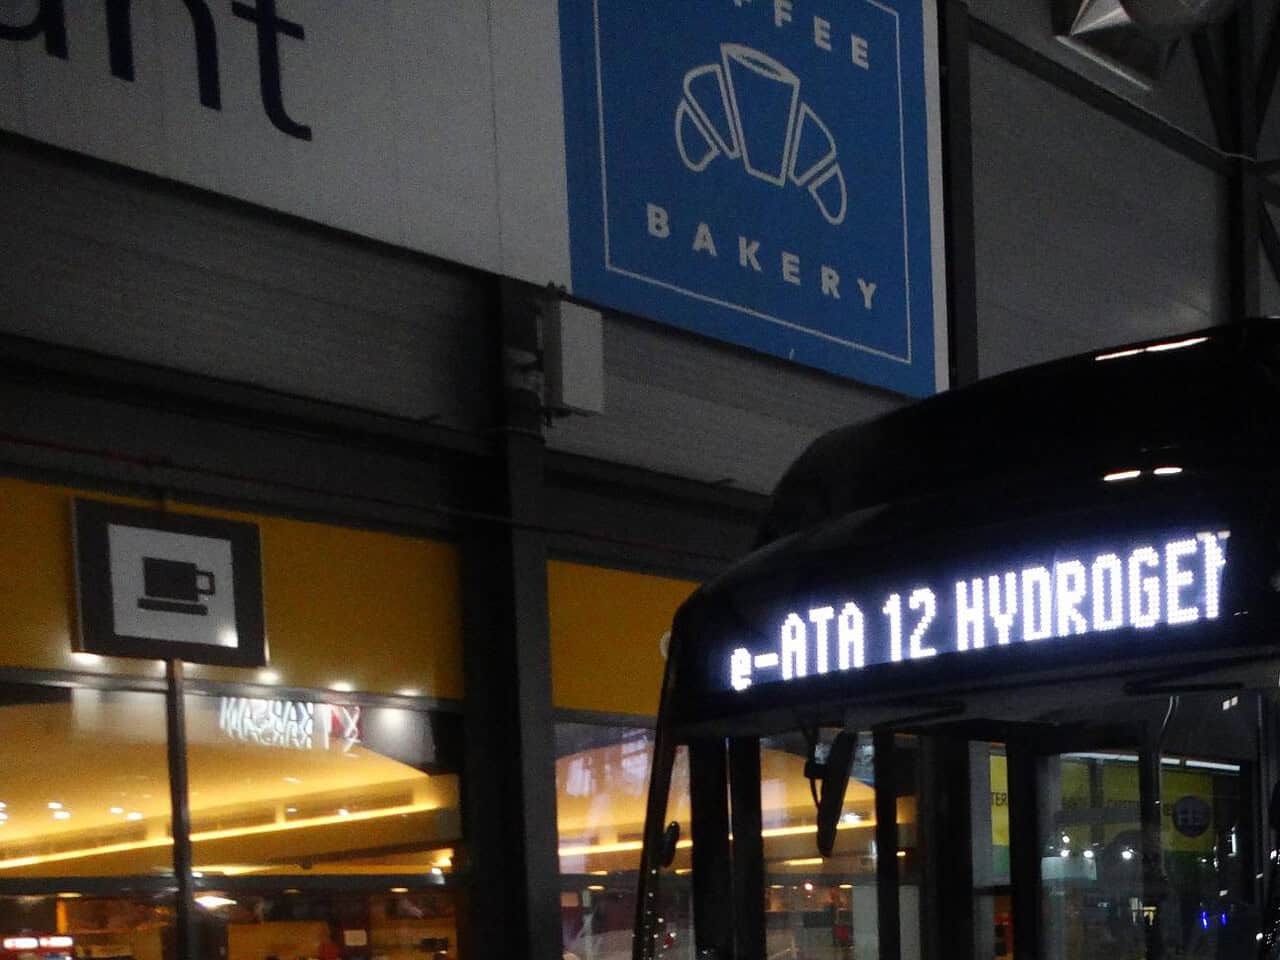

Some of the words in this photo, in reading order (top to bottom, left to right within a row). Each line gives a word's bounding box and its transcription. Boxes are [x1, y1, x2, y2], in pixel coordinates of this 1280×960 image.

[647, 203, 876, 310] BAKERY
[730, 602, 865, 691] e-ATA
[883, 587, 936, 662] 12
